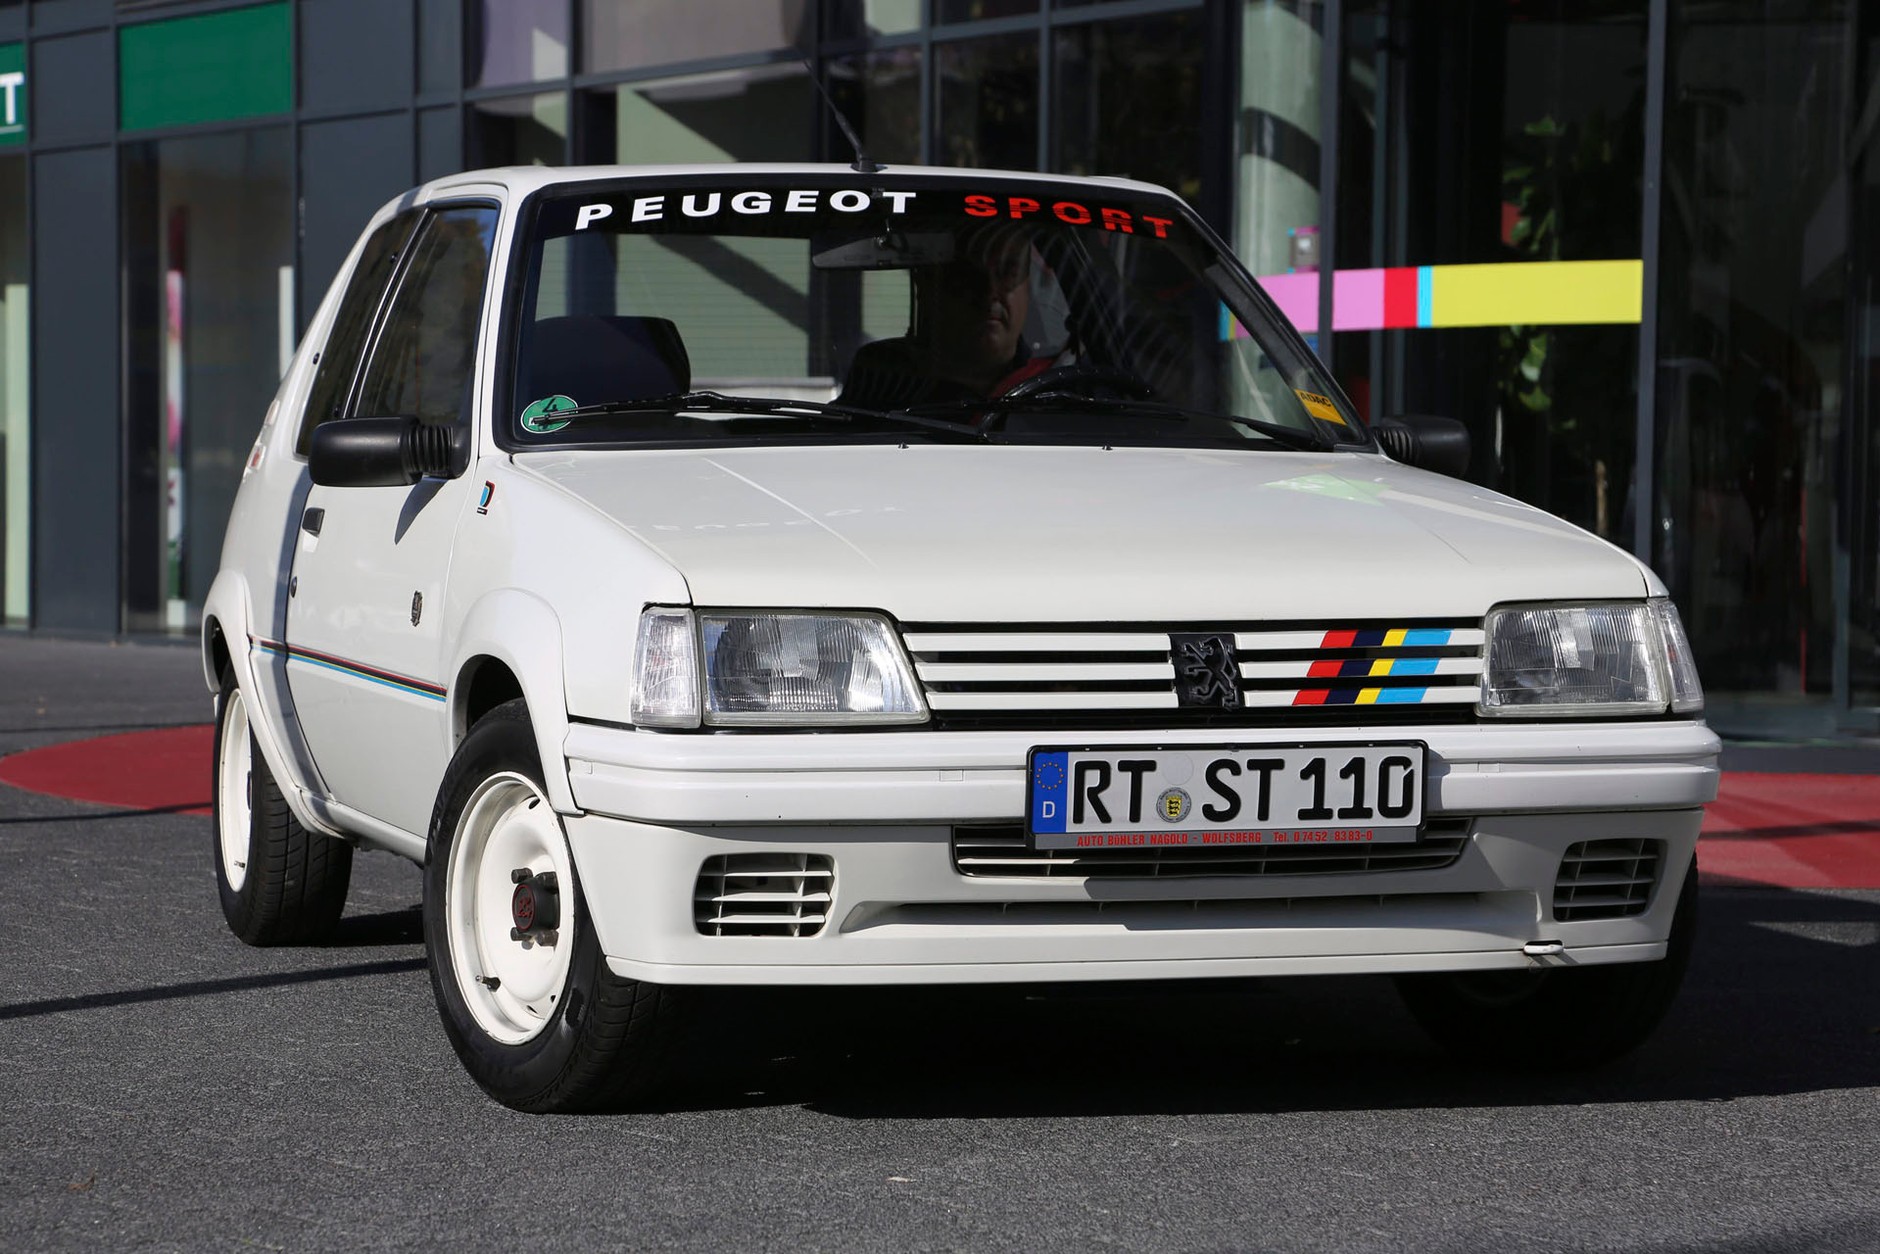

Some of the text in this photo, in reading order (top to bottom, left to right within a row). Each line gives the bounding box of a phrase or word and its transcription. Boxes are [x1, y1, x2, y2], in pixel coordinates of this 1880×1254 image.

[0, 72, 25, 125] T
[575, 190, 1174, 239] PEUGEOT SPORT
[1042, 800, 1056, 819] D
[1072, 760, 1157, 825] RT
[1201, 758, 1286, 823] ST
[1297, 755, 1415, 821] 110
[1076, 834, 1104, 847] AUTO
[1149, 831, 1189, 846] NAGOLD
[1201, 831, 1262, 845] WOLFSBERG
